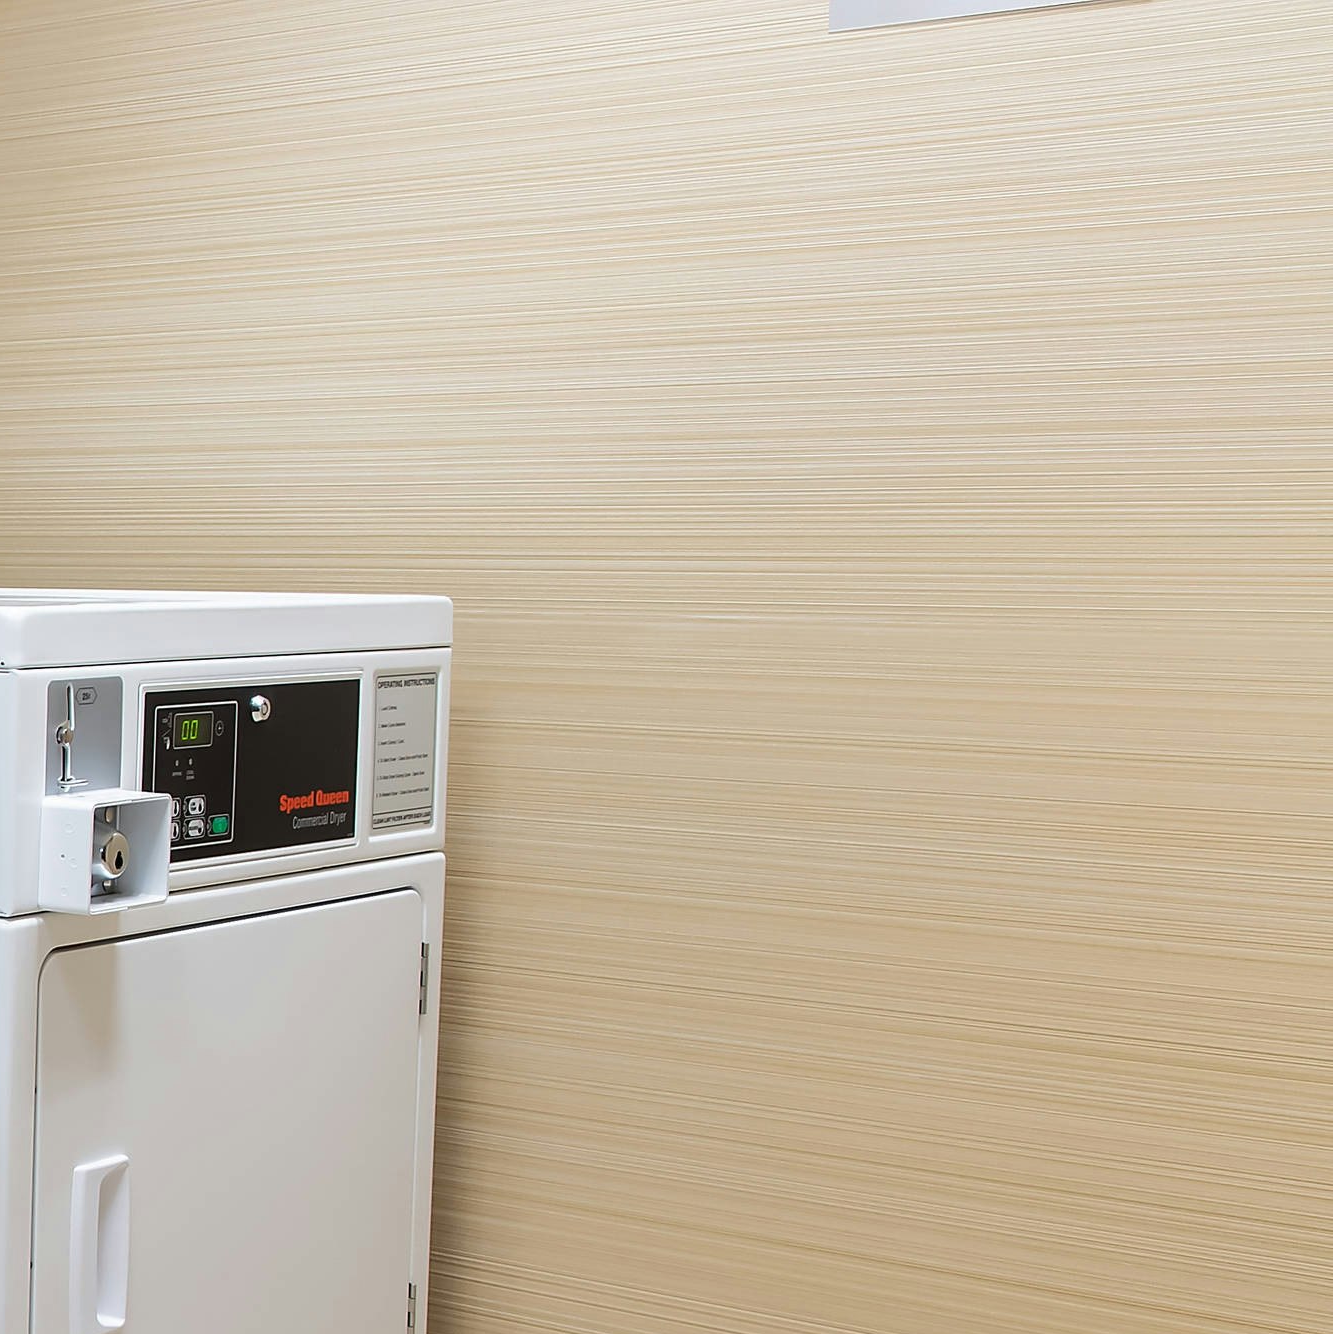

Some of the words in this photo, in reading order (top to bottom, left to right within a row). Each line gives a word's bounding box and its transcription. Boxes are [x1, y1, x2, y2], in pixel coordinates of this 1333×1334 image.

[181, 720, 198, 740] 00
[279, 790, 314, 814] Speed
[316, 789, 349, 806] Queen
[293, 813, 328, 829] Commercial
[330, 811, 347, 826] Dryer
